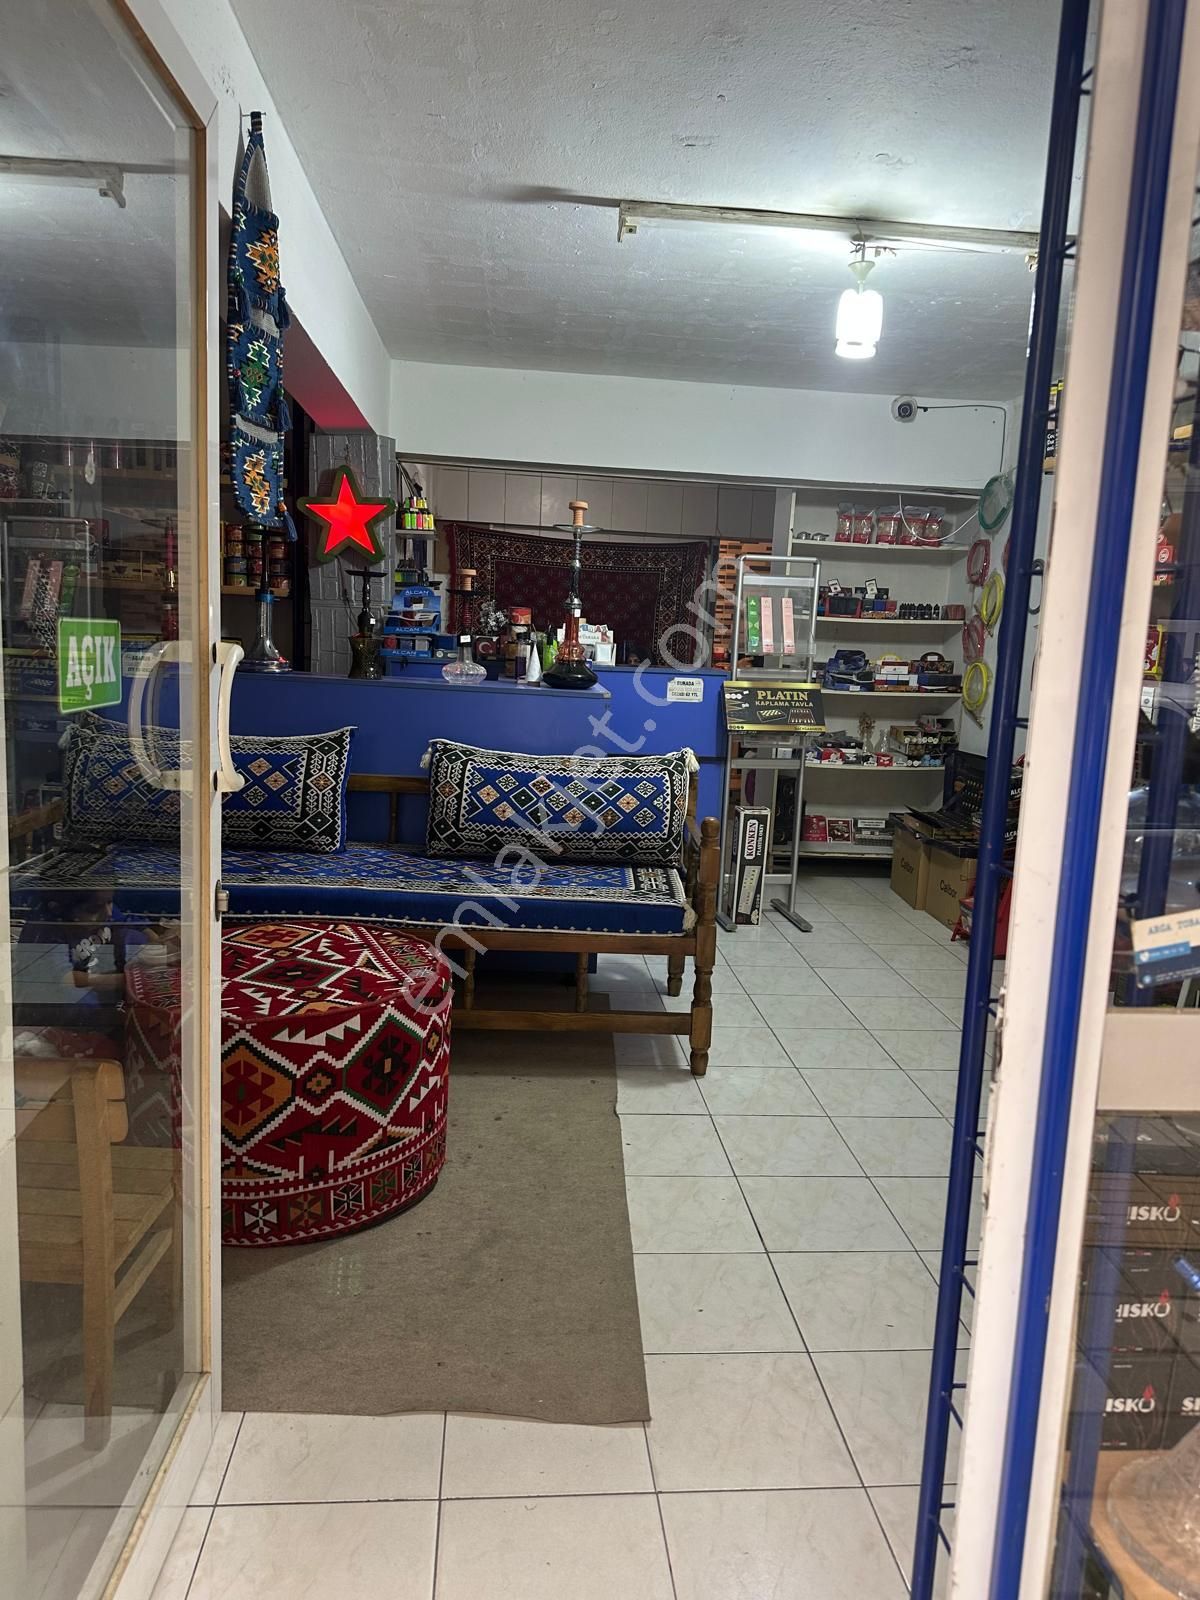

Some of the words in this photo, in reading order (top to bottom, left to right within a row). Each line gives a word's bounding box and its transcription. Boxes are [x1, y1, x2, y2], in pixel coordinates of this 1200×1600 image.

[66, 635, 117, 700] AÇIK
[757, 690, 809, 701] PLATIN
[746, 822, 757, 857] KONKEN
